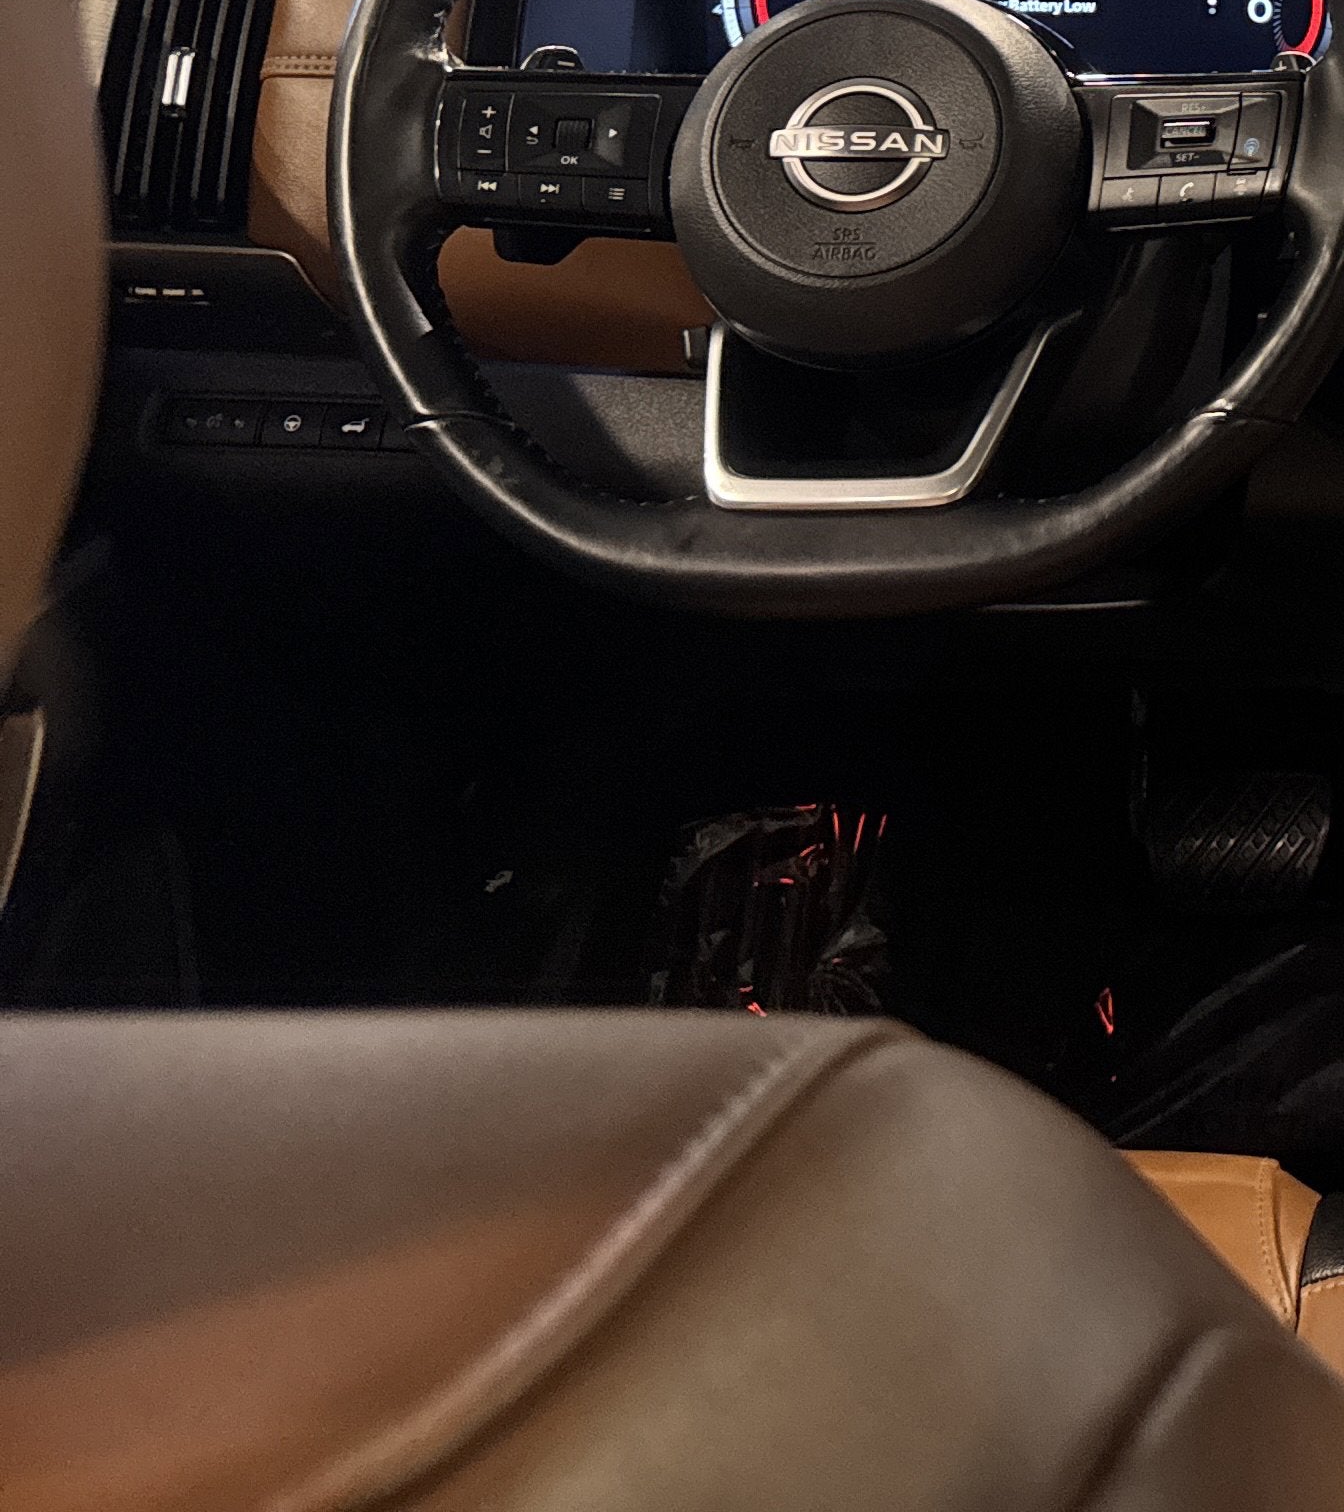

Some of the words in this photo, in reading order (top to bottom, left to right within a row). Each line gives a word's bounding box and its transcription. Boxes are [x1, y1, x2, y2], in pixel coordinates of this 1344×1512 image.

[1064, 0, 1098, 14] Low
[774, 130, 944, 154] NISSAN
[559, 155, 579, 165] OK
[832, 227, 862, 241] SRS
[812, 246, 877, 262] AIRBAG
